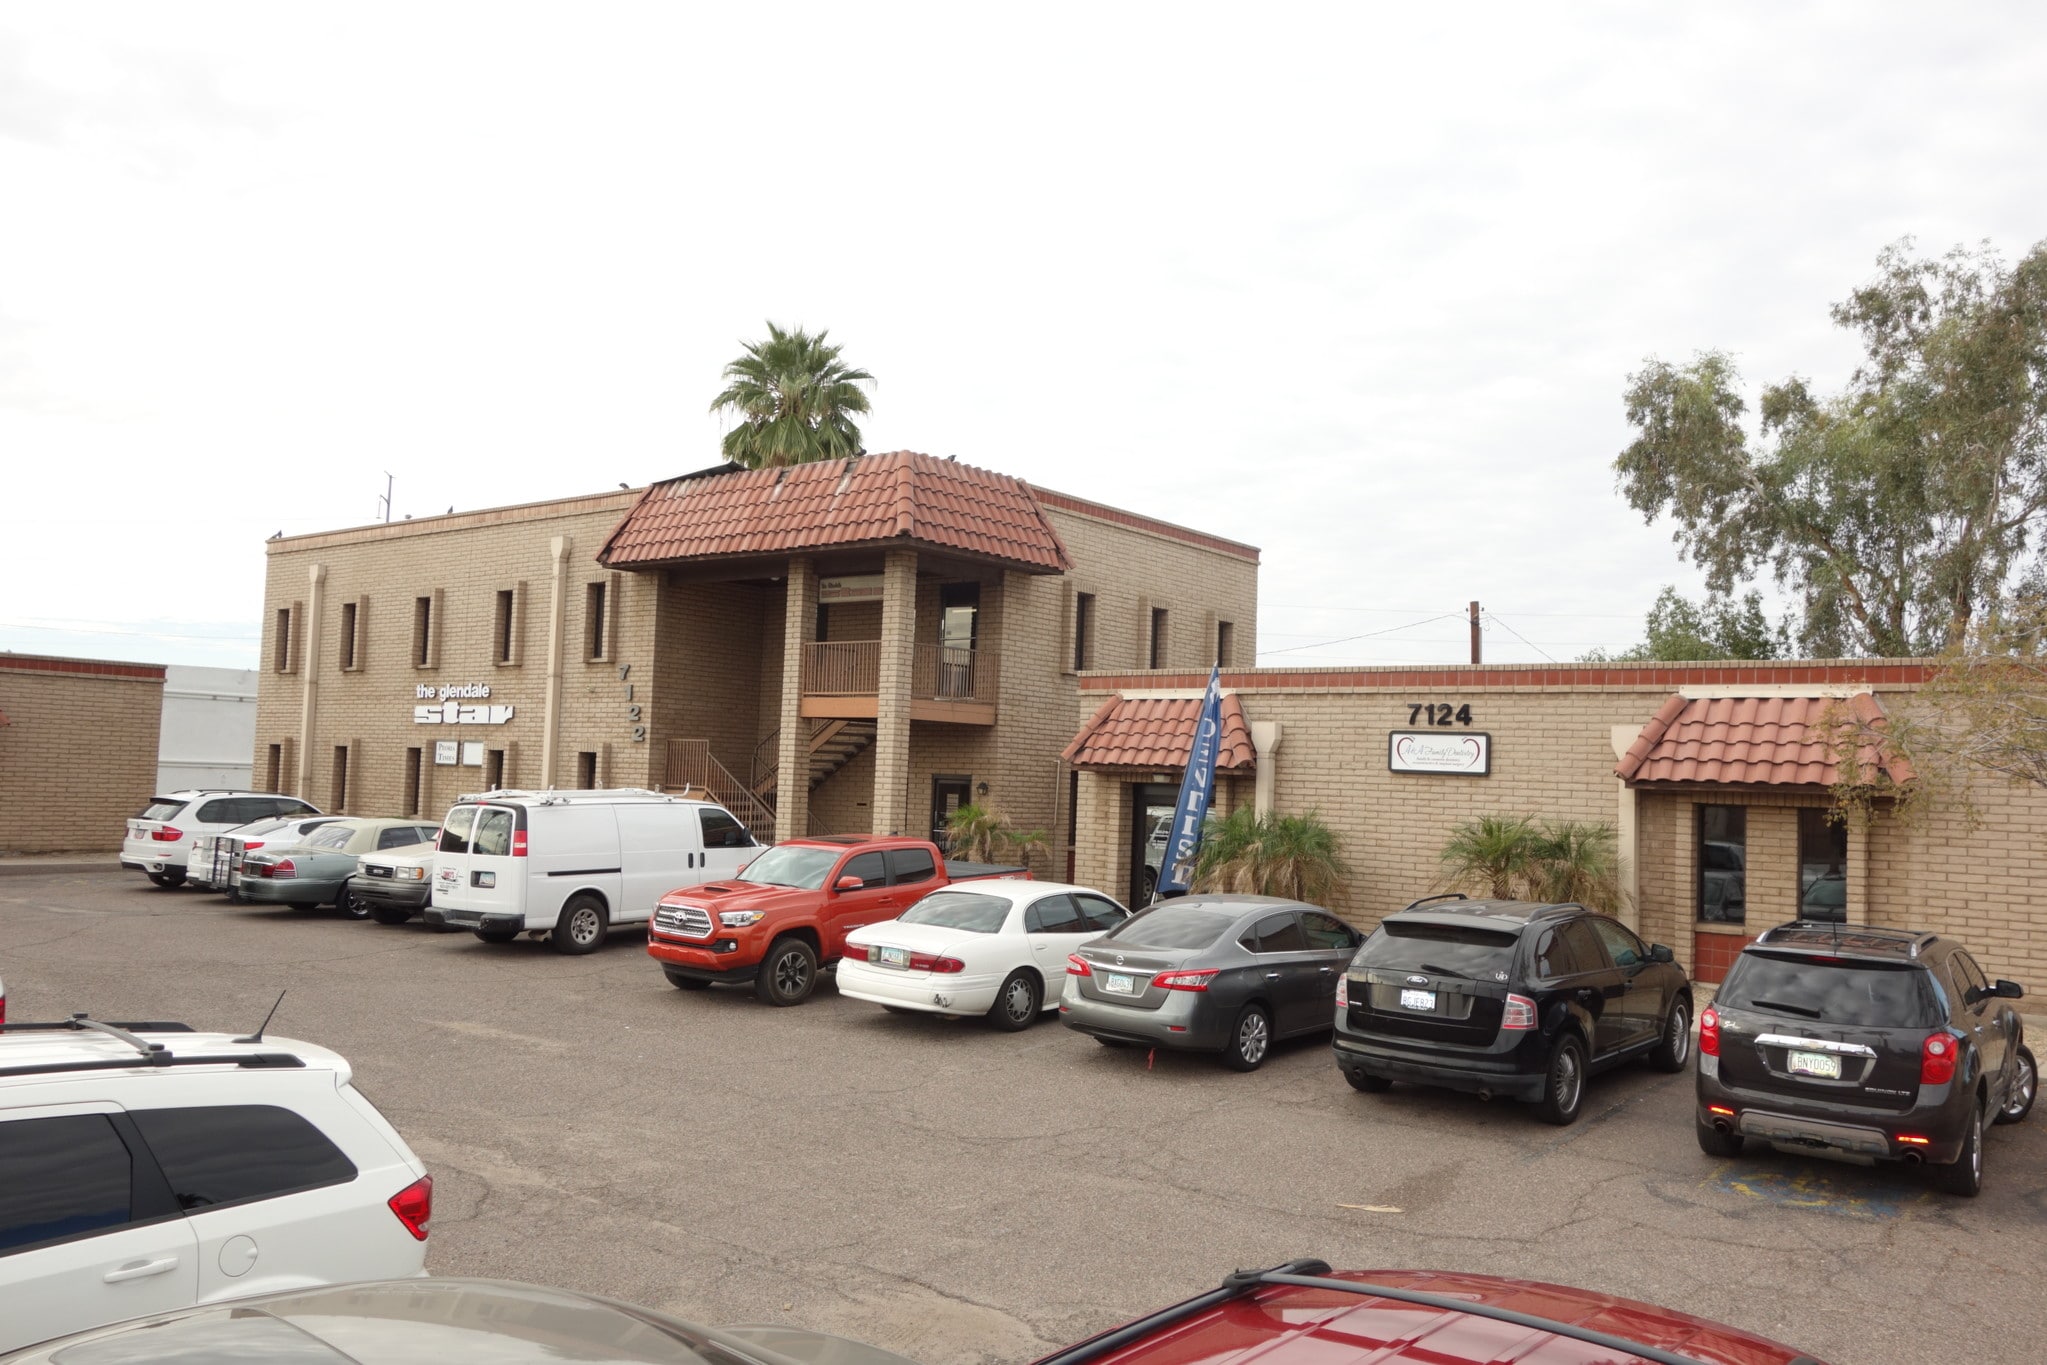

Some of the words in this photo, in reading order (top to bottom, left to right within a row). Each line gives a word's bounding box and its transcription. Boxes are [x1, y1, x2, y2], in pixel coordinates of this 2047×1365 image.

[416, 683, 436, 699] the
[439, 682, 491, 702] glendale
[617, 663, 645, 742] 7122
[413, 701, 515, 724] star
[1407, 703, 1473, 726] 7124
